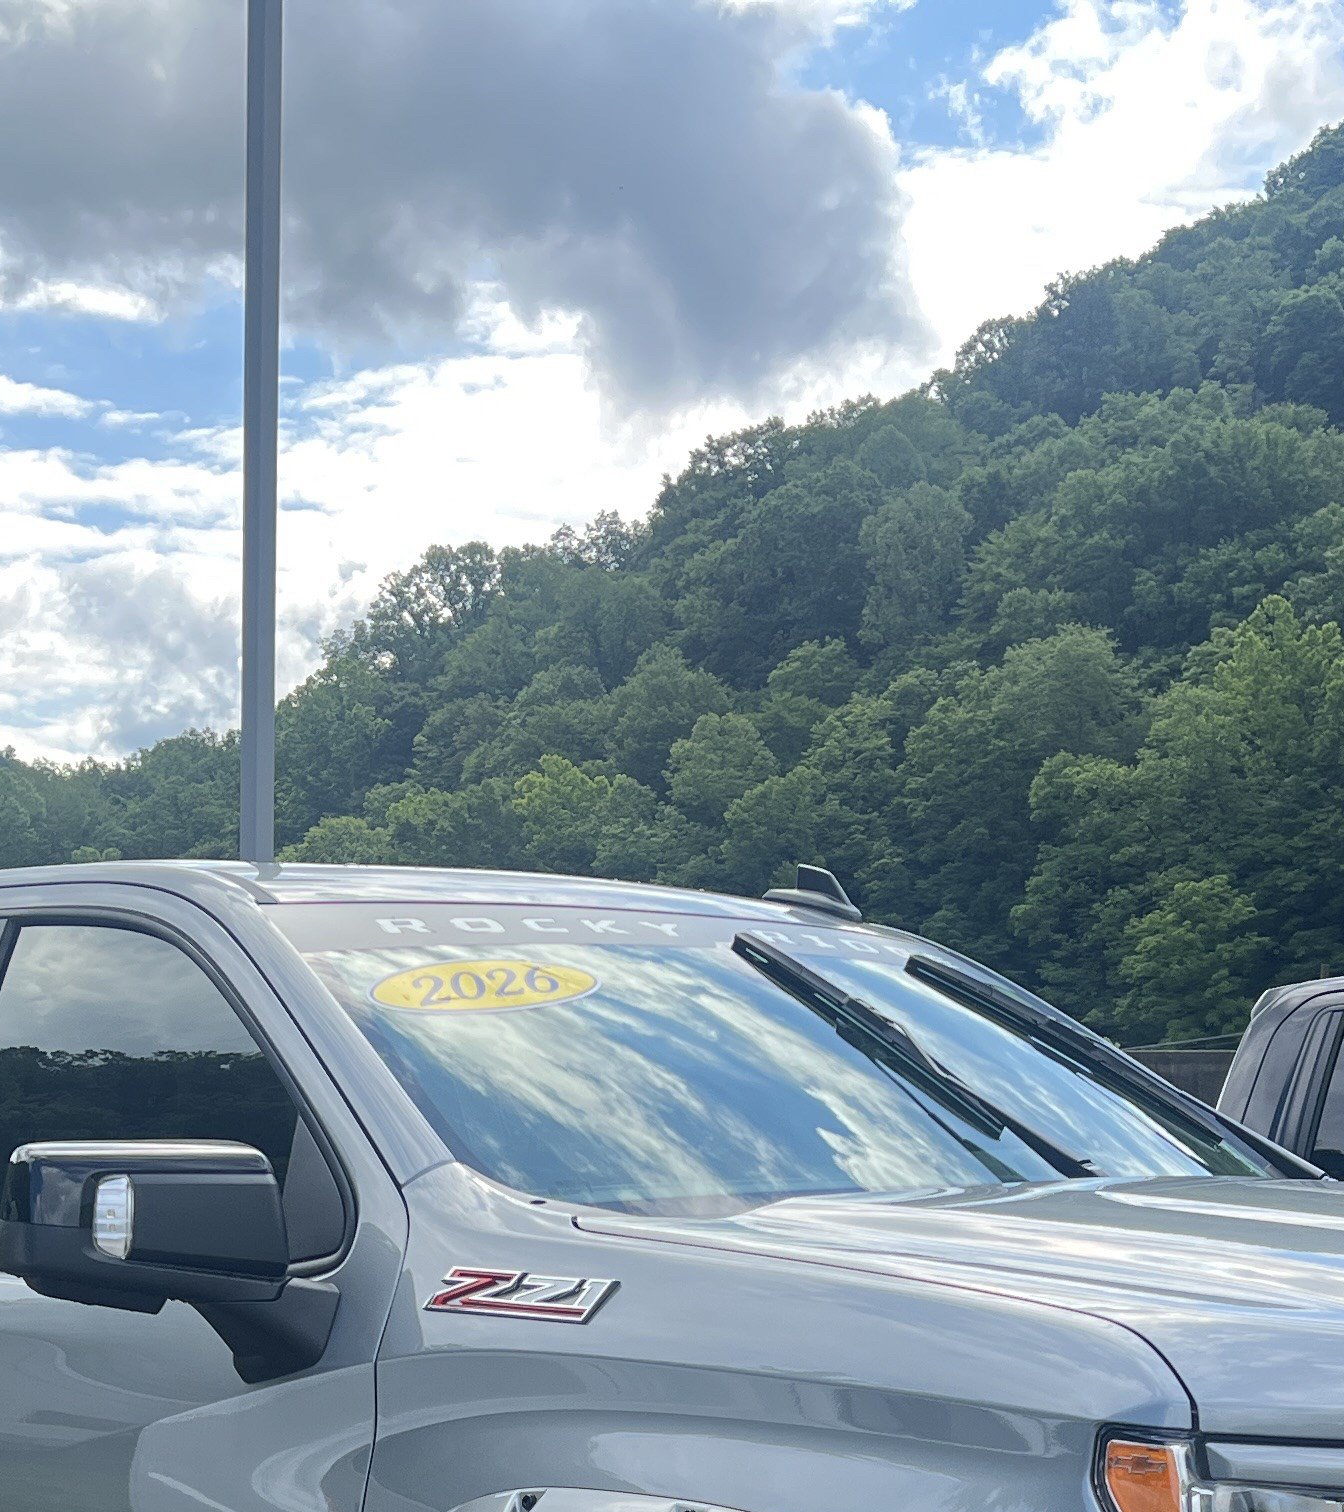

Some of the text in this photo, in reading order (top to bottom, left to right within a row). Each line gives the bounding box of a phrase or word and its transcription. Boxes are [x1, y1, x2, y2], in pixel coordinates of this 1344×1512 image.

[375, 917, 680, 938] ROCKY
[412, 967, 560, 1008] 2026
[423, 1265, 622, 1325] Z71
